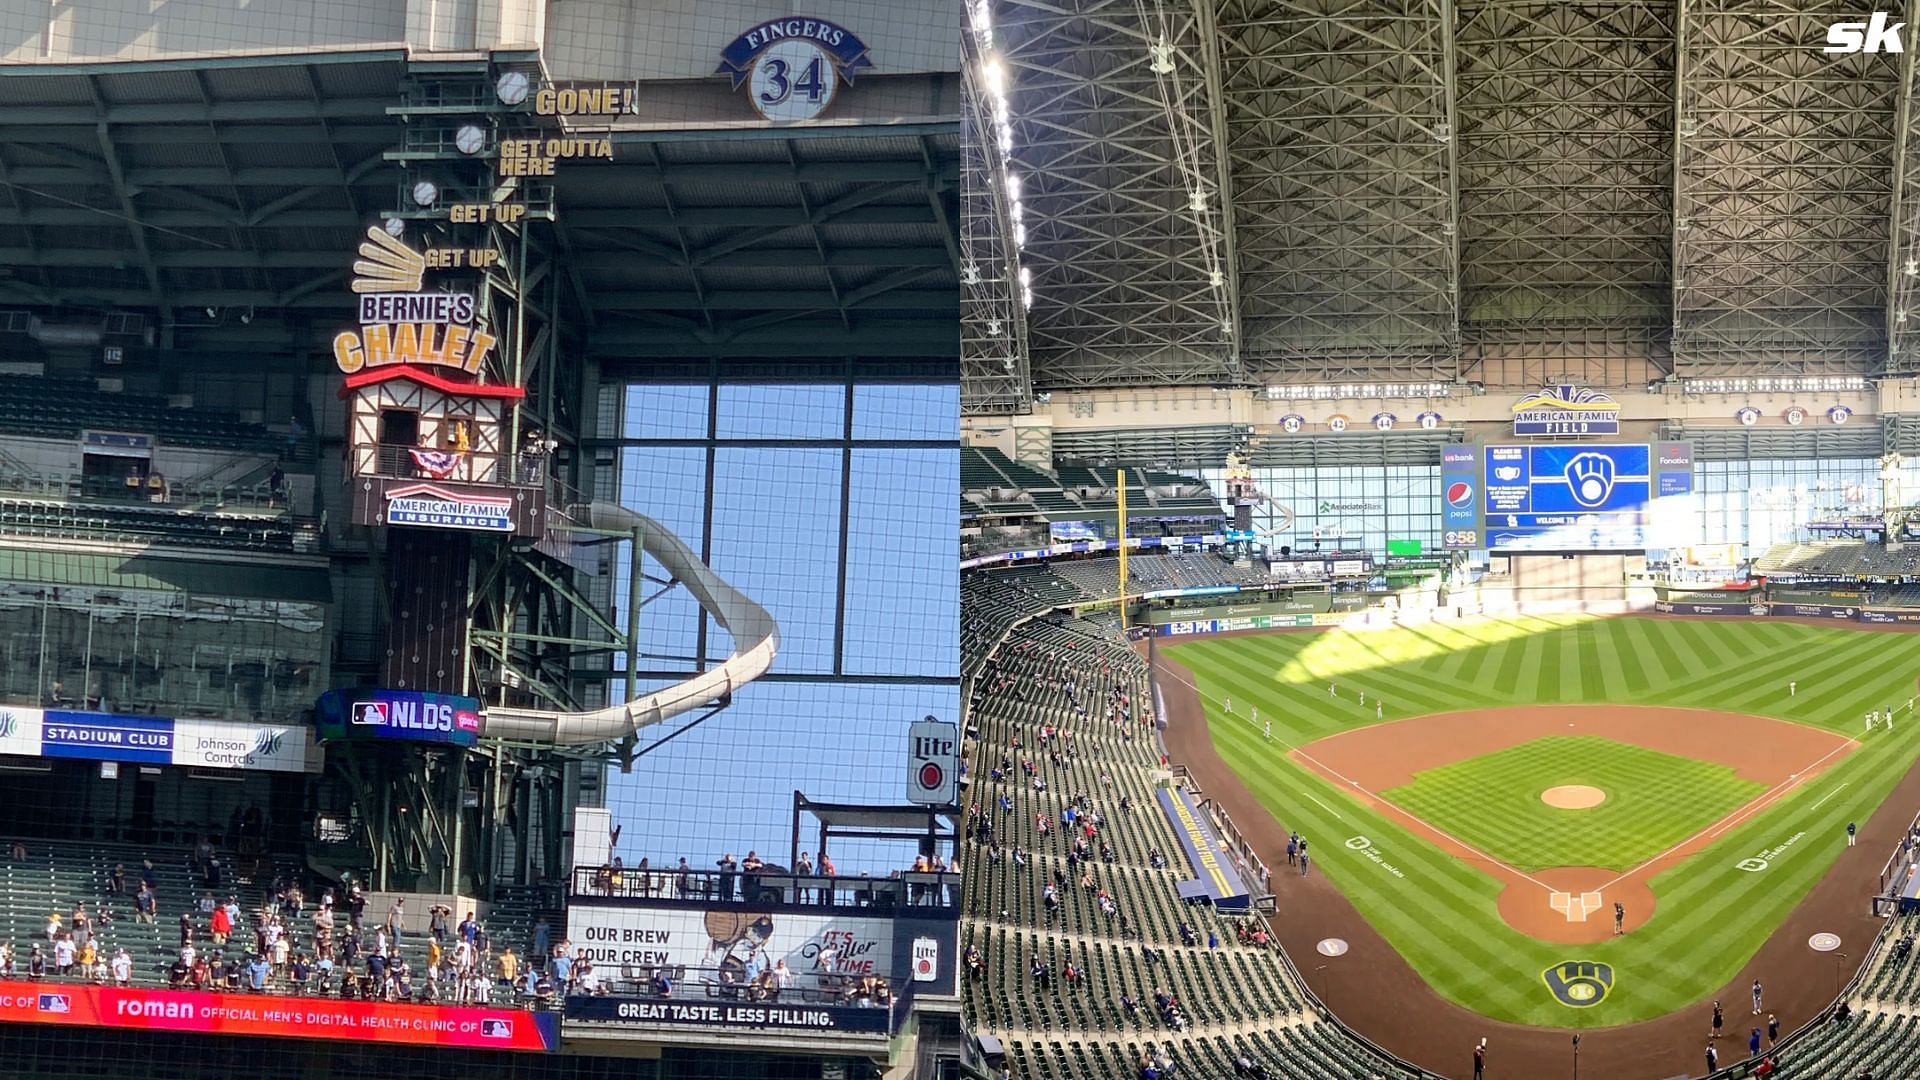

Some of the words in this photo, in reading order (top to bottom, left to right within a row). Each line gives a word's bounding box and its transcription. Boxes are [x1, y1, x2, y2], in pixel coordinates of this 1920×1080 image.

[745, 20, 844, 49] FINGERS
[760, 54, 826, 105] 34
[536, 88, 632, 116] GONE!
[501, 139, 541, 158] GET
[546, 138, 614, 157] OUTTA
[500, 157, 555, 176] HERE
[450, 204, 490, 223] GET
[495, 203, 526, 222] UP
[425, 248, 465, 267] GET
[469, 248, 499, 267] UP
[360, 293, 474, 324] BERNIE'S
[333, 323, 497, 375] CHALET
[1378, 419, 1390, 428] 44
[1516, 413, 1573, 421] AMERICAN
[1578, 411, 1617, 421] FAMILY
[1286, 421, 1298, 430] 34
[1332, 420, 1344, 429] 42
[1546, 423, 1588, 433] FIELD
[391, 500, 458, 513] AMERICAN
[463, 504, 508, 517] FAMILY
[1451, 510, 1472, 518] pepsi
[399, 512, 499, 527] INSURANCE
[1457, 531, 1477, 543] 58
[1171, 622, 1193, 634] 6:29
[1196, 621, 1212, 633] PM
[391, 701, 451, 731] NLDS
[47, 728, 121, 743] STADIUM
[128, 733, 168, 746] CLUB
[197, 737, 246, 751] Johnson
[915, 737, 952, 760] Lite
[205, 752, 255, 766] Controls
[586, 927, 618, 942] OUR
[623, 929, 670, 944] BREW
[823, 931, 854, 944] IT'S
[585, 948, 617, 962] OUR
[622, 950, 669, 964] CREW
[916, 946, 936, 959] Lite
[836, 959, 873, 973] TIME
[16, 996, 35, 1008] OF
[117, 999, 193, 1018] roman
[200, 1007, 258, 1021] OFFICIAL
[263, 1011, 302, 1024] MEN'S
[306, 1013, 357, 1026] DIGITAL
[361, 1017, 409, 1029] HEALTH
[413, 1019, 456, 1032] CLINIC
[460, 1022, 477, 1033] OF
[618, 1003, 668, 1019] GREAT
[671, 1006, 723, 1021] TASTE.
[727, 1008, 765, 1022] LESS
[769, 1010, 834, 1026] FILLING.
